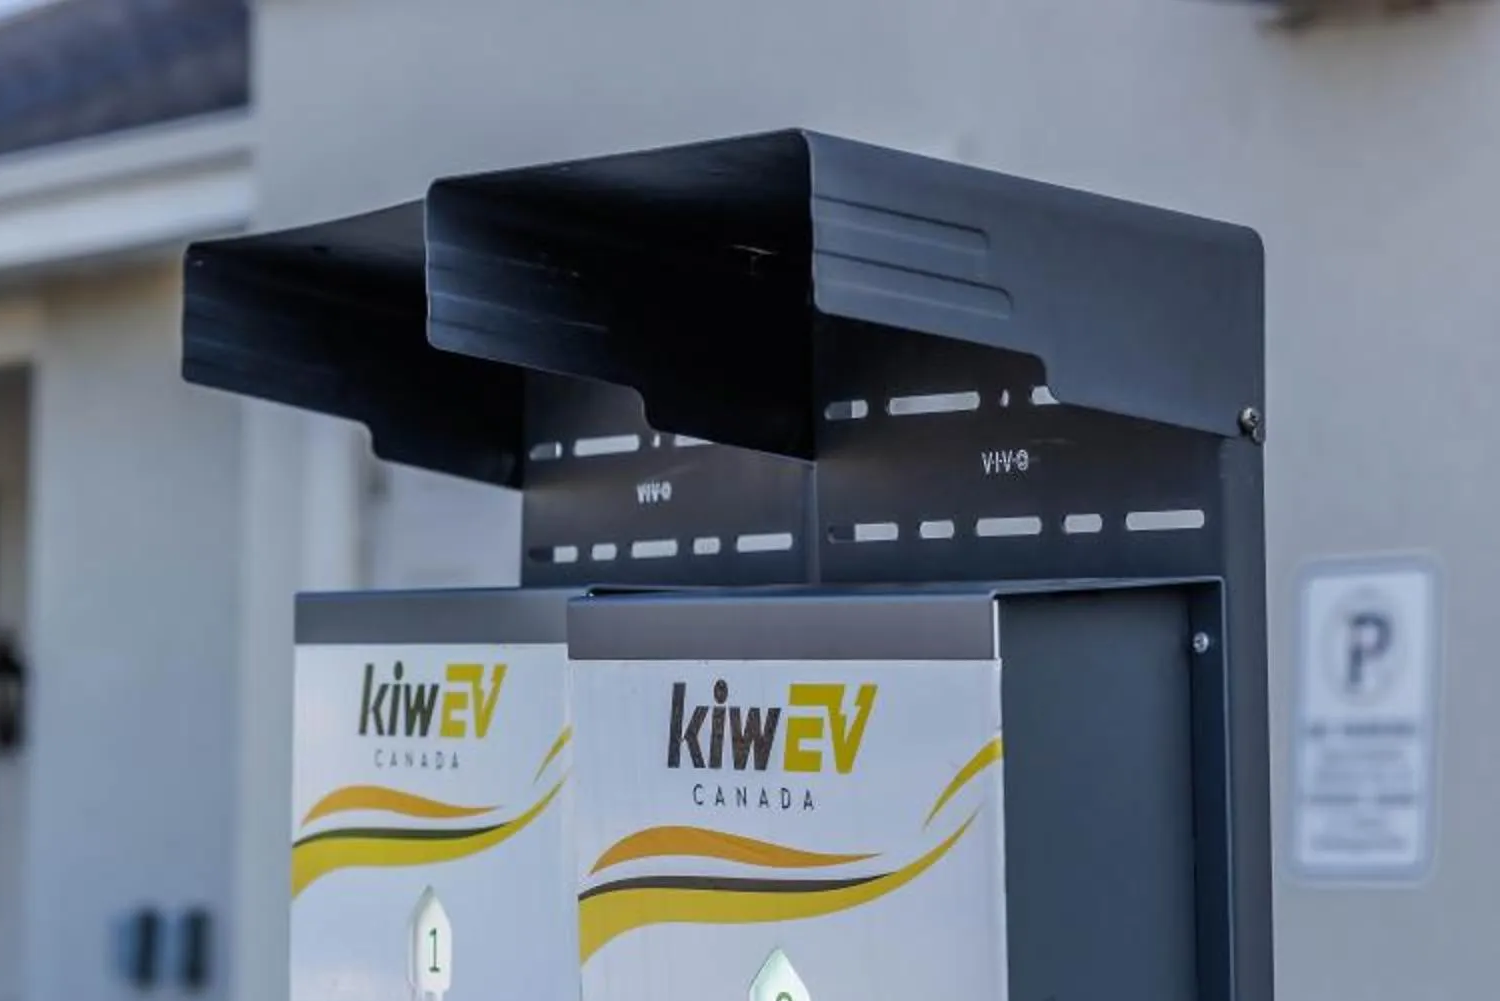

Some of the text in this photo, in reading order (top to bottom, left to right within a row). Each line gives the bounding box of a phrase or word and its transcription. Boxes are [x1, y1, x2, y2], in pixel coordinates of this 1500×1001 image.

[980, 449, 1029, 474] VIVO
[358, 660, 508, 738] kiwEV
[667, 679, 878, 774] kiwEV
[374, 748, 459, 770] CANADA
[692, 783, 815, 811] CANADA
[428, 927, 441, 973] 1
